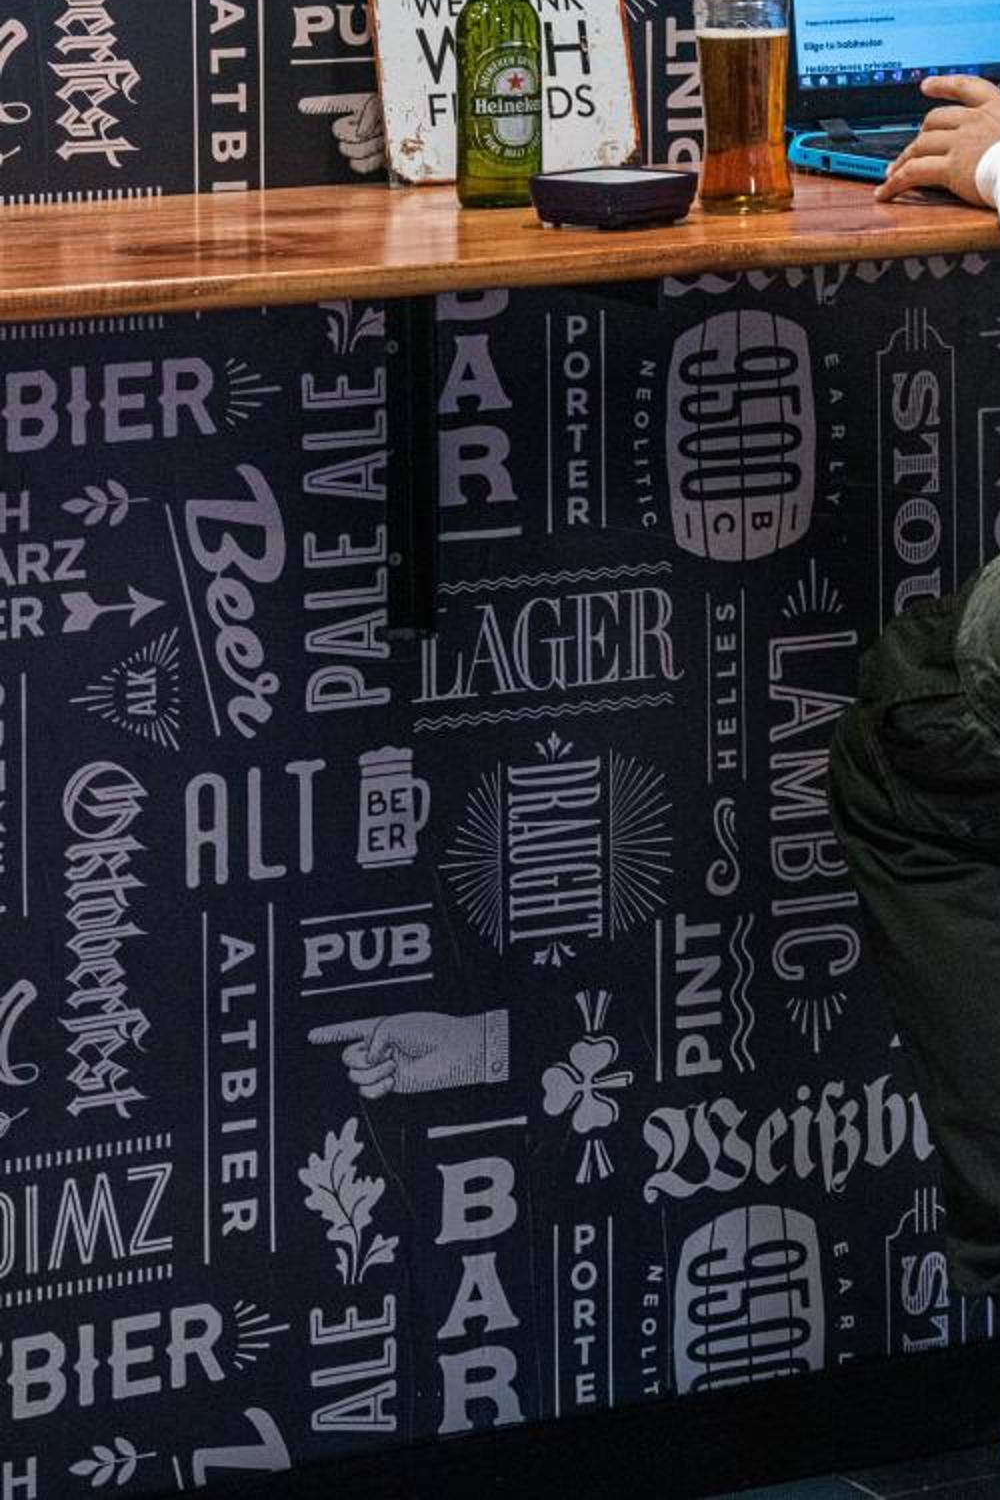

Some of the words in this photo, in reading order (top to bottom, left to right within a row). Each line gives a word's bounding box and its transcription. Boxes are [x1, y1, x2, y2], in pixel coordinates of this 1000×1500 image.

[291, 3, 371, 48] PU
[416, 19, 591, 85] WH
[1, 357, 217, 453] BIER
[300, 366, 388, 501] ALE
[563, 315, 591, 526] PORTER
[635, 359, 658, 528] NEOLITIC
[677, 345, 801, 501] 9500
[823, 352, 846, 506] EARLY
[181, 463, 287, 739] Beer
[303, 524, 391, 713] PALE
[125, 666, 157, 716] ALK
[715, 603, 737, 770] HELLES
[184, 758, 327, 889] ALT
[366, 787, 408, 817] BE
[367, 823, 407, 852] ER
[507, 757, 602, 940] DRAUGHT
[57, 760, 151, 1119] Oktoberfest
[302, 922, 432, 979] PUB
[675, 913, 723, 1077] PINT
[220, 934, 259, 1237] ALTBIER
[6, 1303, 226, 1420] BIER
[309, 1293, 397, 1432] ALE
[433, 1156, 526, 1435] BAR
[570, 1223, 598, 1404] PORTE
[640, 1265, 664, 1395] NEOLIT
[832, 1240, 855, 1365] EARL
